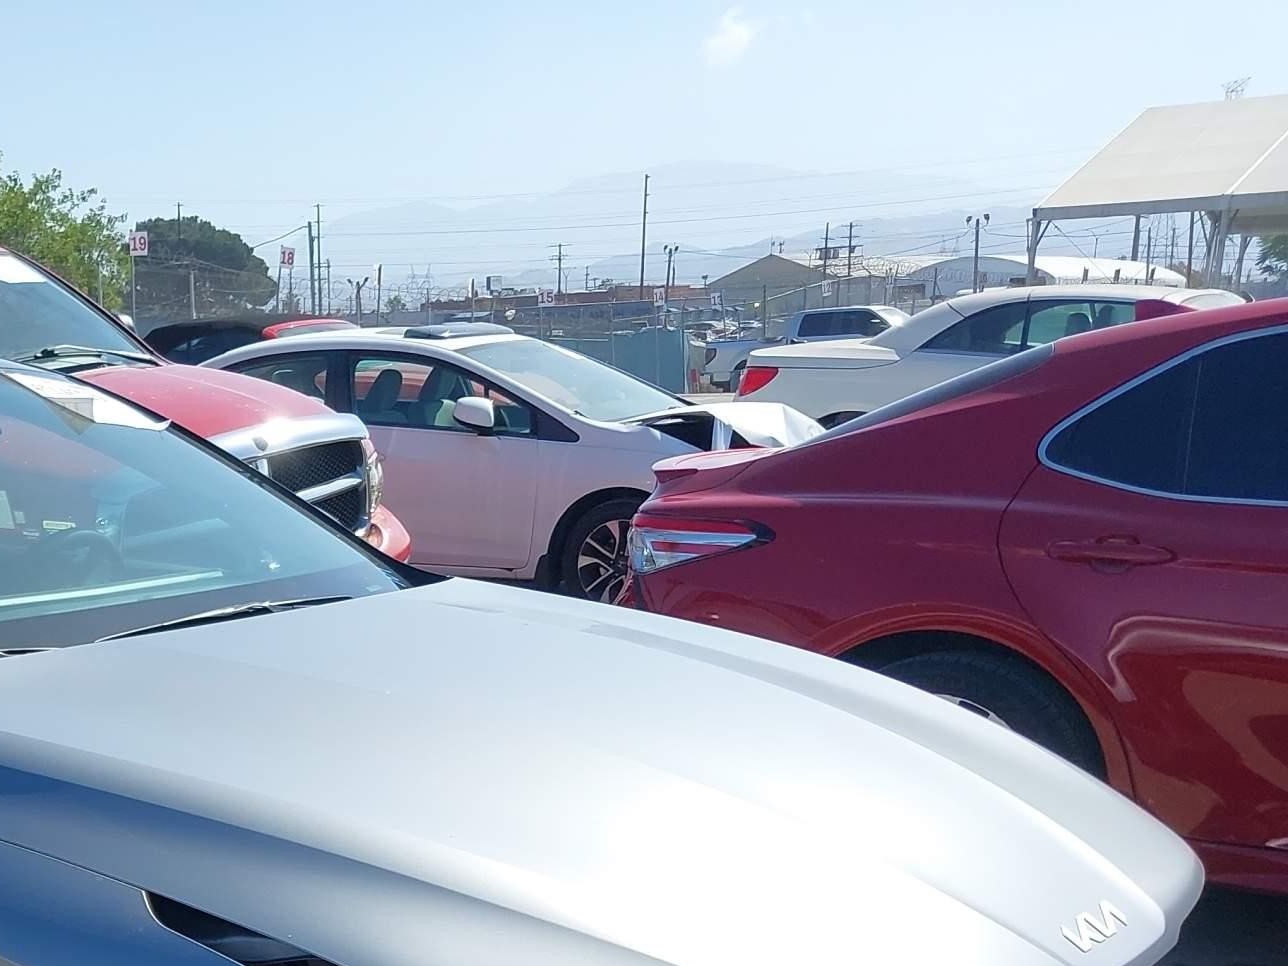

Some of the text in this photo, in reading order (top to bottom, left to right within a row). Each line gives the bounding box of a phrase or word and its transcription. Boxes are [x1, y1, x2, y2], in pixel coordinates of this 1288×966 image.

[131, 236, 147, 251] 19
[280, 250, 294, 266] 18
[538, 291, 553, 304] 15
